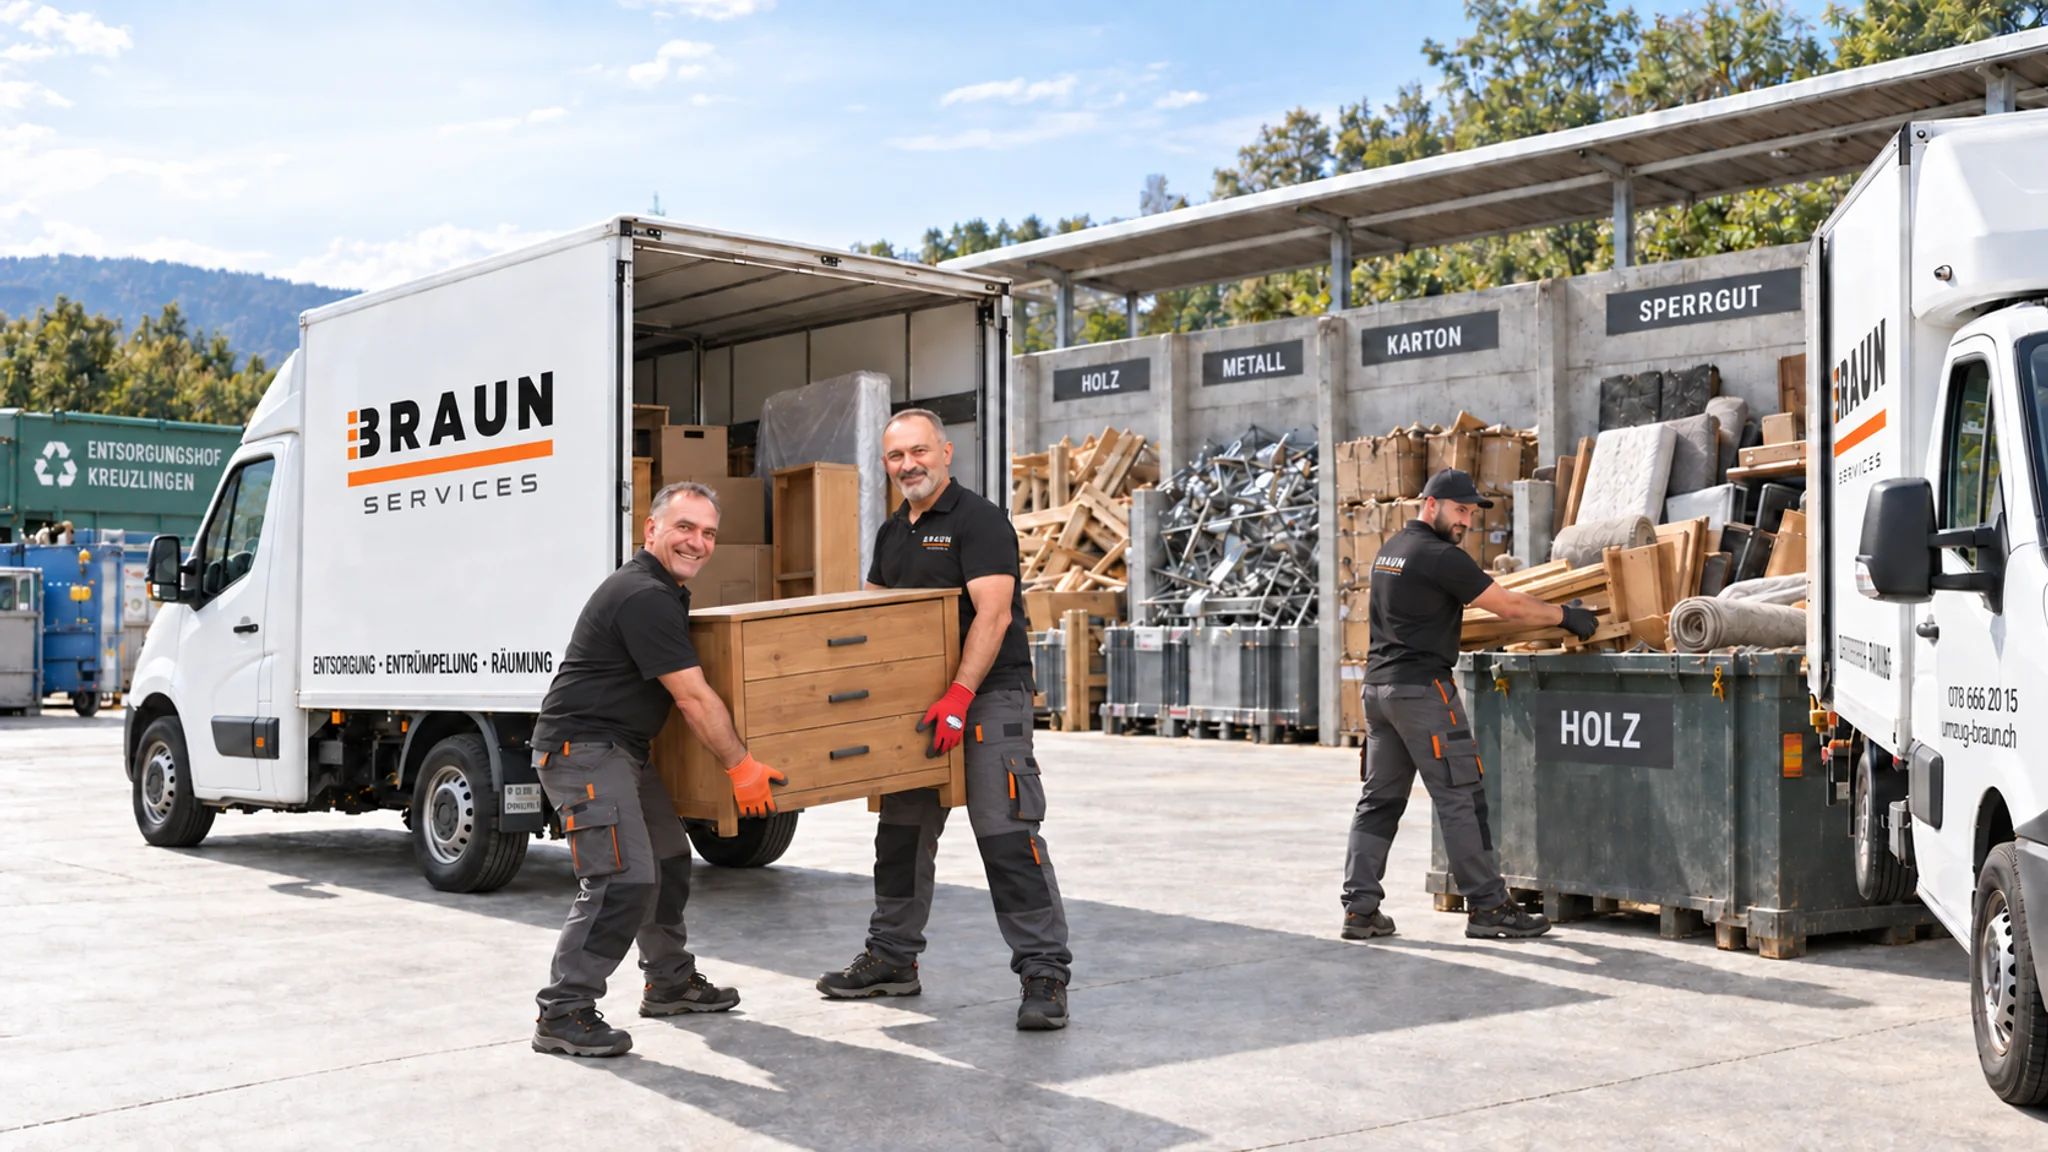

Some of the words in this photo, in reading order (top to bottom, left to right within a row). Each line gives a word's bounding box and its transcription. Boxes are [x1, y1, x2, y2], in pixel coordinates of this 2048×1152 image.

[1638, 284, 1762, 323] SPERRGUT
[1387, 325, 1462, 355] KARTON
[1222, 351, 1286, 378] METALL
[1081, 370, 1120, 392] HOLZ
[347, 371, 554, 460] BRAUN
[87, 440, 222, 467] ENTSORGUNGSHOF
[87, 467, 195, 491] KREUZLINGEN
[363, 473, 538, 514] SERVICES
[313, 655, 376, 675] ENTSORGUNG
[386, 650, 478, 674] ENTRÜMPELUNG
[491, 648, 553, 674] RÄUMUNG
[1948, 686, 1965, 708] 078
[1966, 686, 1986, 710] 666
[1987, 687, 2002, 711] 20
[2003, 688, 2018, 713] 15
[1560, 710, 1641, 749] HOLZ
